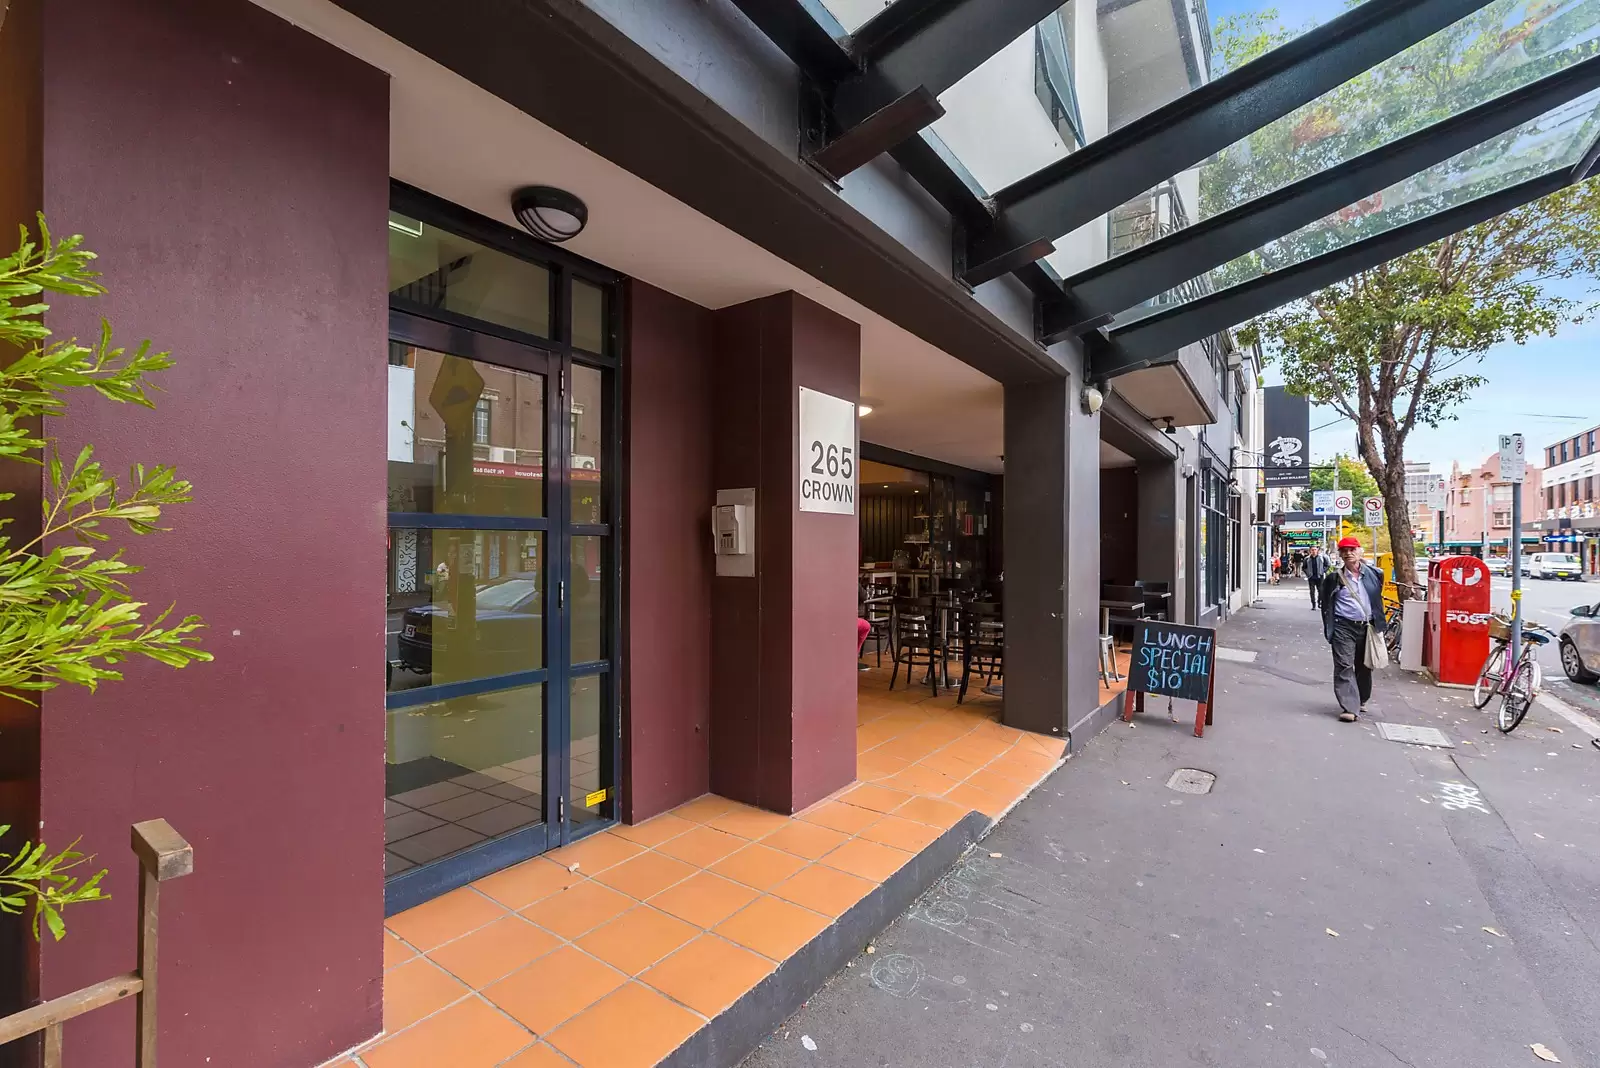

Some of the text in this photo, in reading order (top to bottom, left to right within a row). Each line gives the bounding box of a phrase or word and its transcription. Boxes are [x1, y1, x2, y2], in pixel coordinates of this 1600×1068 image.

[811, 440, 852, 479] 265
[802, 479, 853, 503] CROWN
[1144, 628, 1212, 652] LUNCH
[1138, 646, 1208, 676] SPECIAL
[1146, 667, 1182, 691] $10
